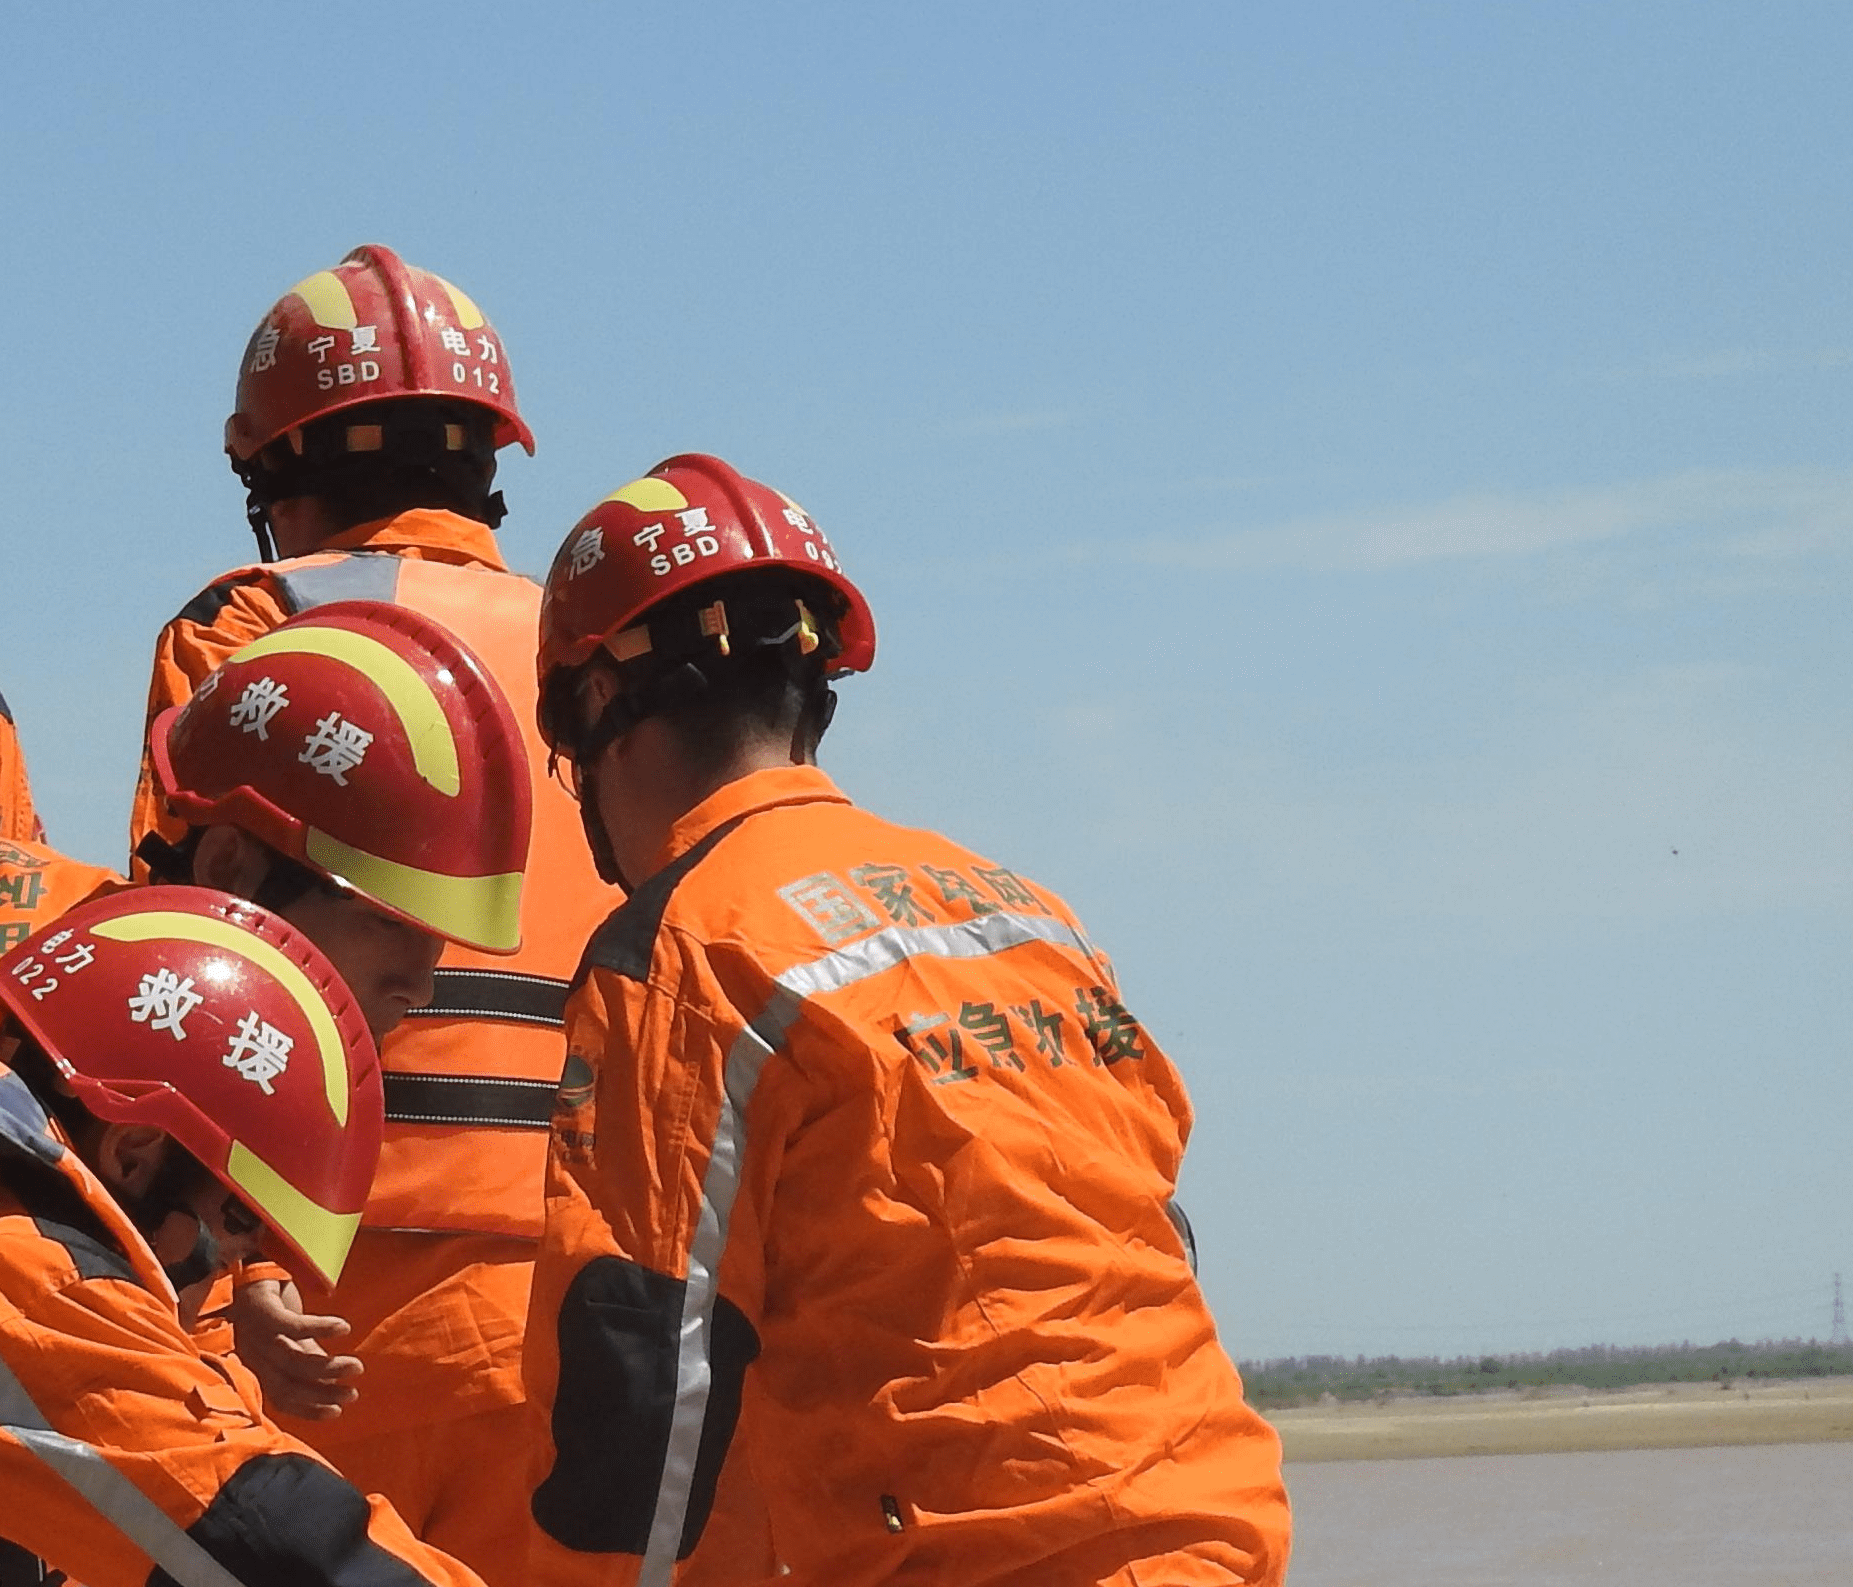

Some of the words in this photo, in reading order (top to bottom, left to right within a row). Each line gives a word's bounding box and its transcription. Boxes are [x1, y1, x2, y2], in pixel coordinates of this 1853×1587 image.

[308, 325, 381, 363] 宁夏
[441, 326, 498, 364] 电力
[317, 361, 380, 390] SBD
[453, 362, 500, 394] 012
[633, 507, 716, 552] 宁夏
[650, 536, 719, 576] SBD
[230, 677, 373, 786] 救援
[777, 863, 1052, 945] 国家电网
[41, 928, 96, 973] 电力
[12, 956, 58, 1000] 022
[128, 968, 294, 1096] 救援
